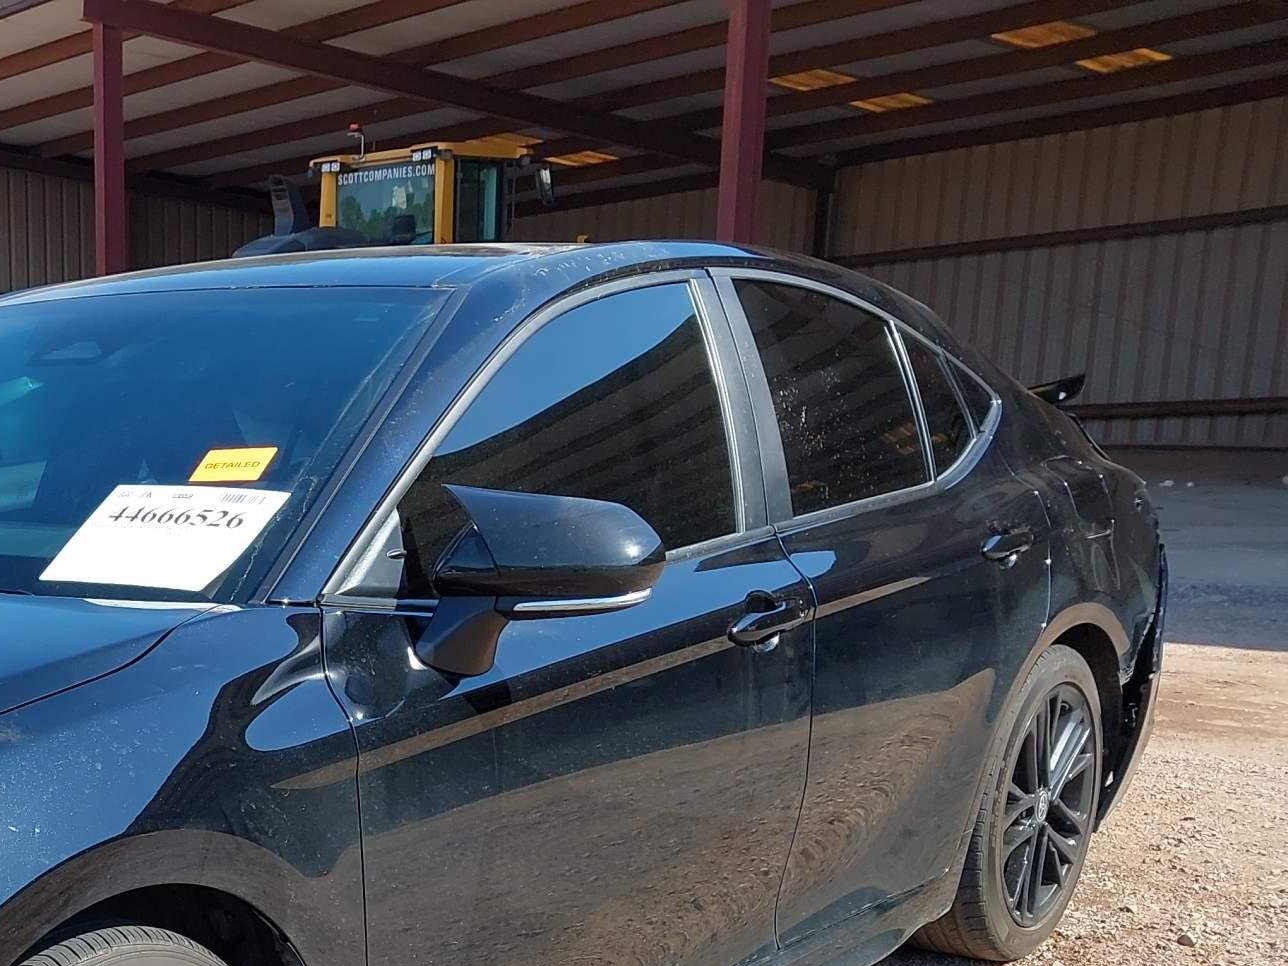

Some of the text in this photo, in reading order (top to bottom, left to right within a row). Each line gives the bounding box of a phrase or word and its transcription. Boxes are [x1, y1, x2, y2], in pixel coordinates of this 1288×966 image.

[338, 164, 434, 186] SCOTTCOMPANIES.COM
[204, 461, 261, 470] DETAILED
[108, 505, 247, 529] 44666526
